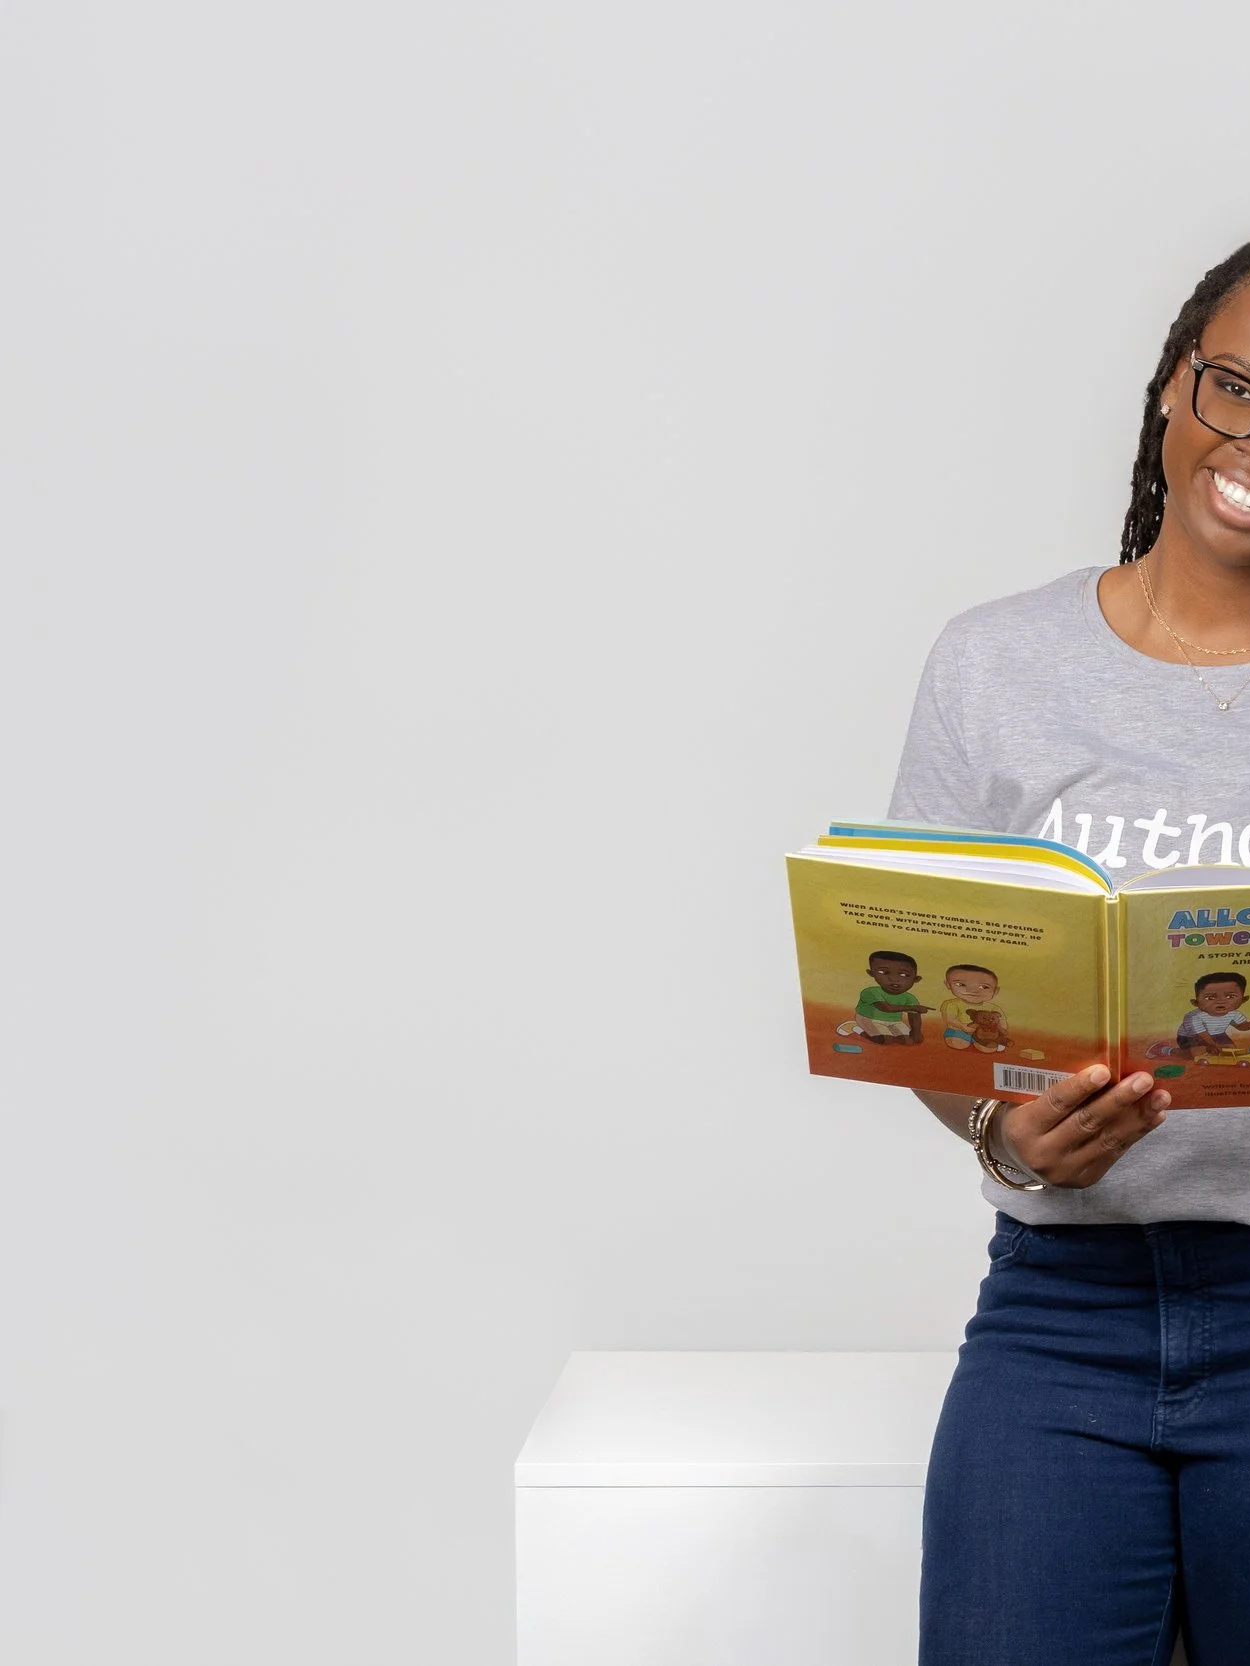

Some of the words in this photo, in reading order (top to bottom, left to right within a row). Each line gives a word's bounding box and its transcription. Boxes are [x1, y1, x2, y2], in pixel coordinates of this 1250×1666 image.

[843, 910, 865, 918] TAKE
[896, 917, 919, 925] WITH
[921, 920, 963, 930] PATIENCE
[856, 920, 890, 928] LEARNS
[906, 911, 937, 919] TOWER
[1003, 923, 1044, 933] FEELINGS
